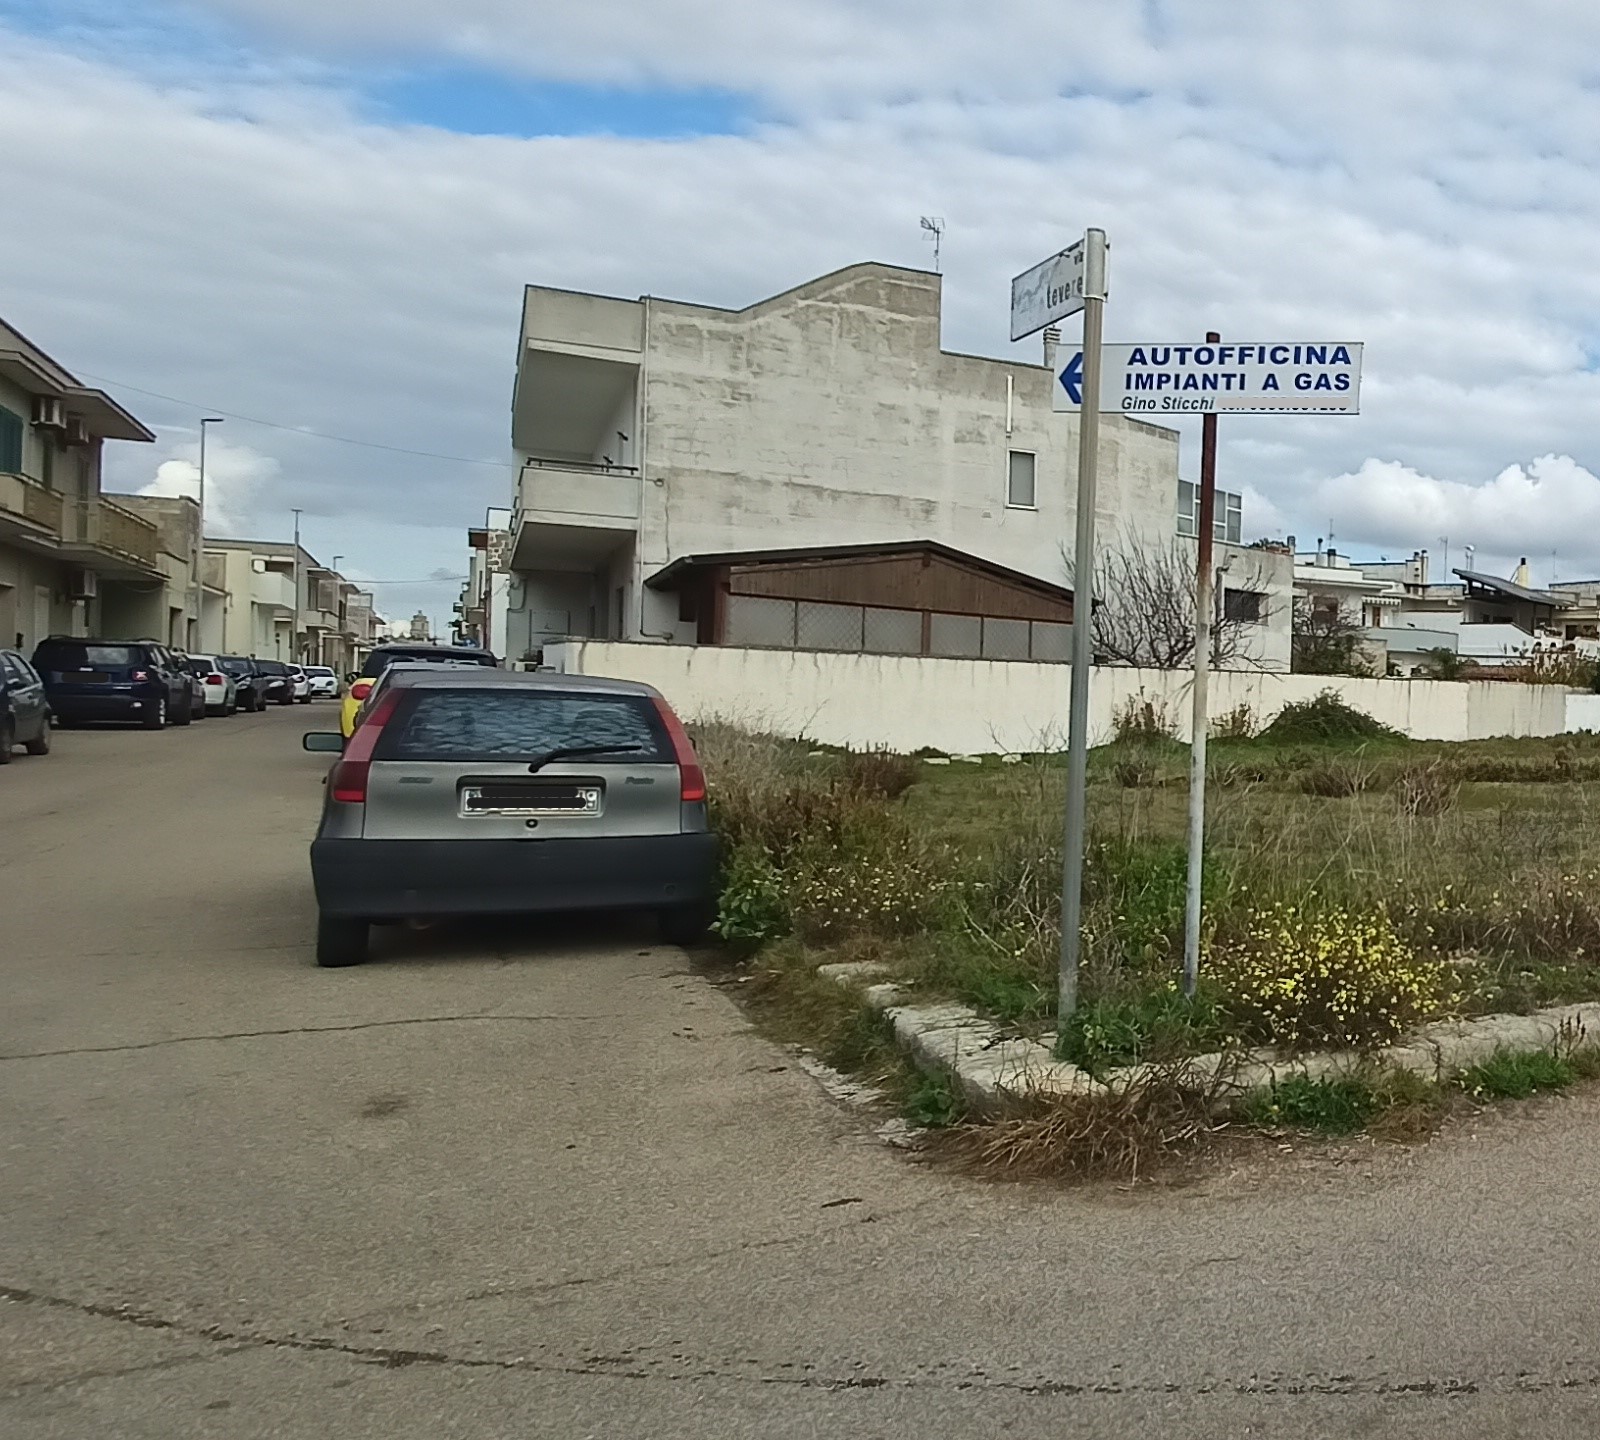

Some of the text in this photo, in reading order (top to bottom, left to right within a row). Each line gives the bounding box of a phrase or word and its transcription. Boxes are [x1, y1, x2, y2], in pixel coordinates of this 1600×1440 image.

[1127, 346, 1351, 366] AUTOFFICINA
[1125, 373, 1350, 391] IMPIANTI A GAS
[1121, 396, 1157, 410] Gino
[1161, 396, 1215, 410] Sticchi
